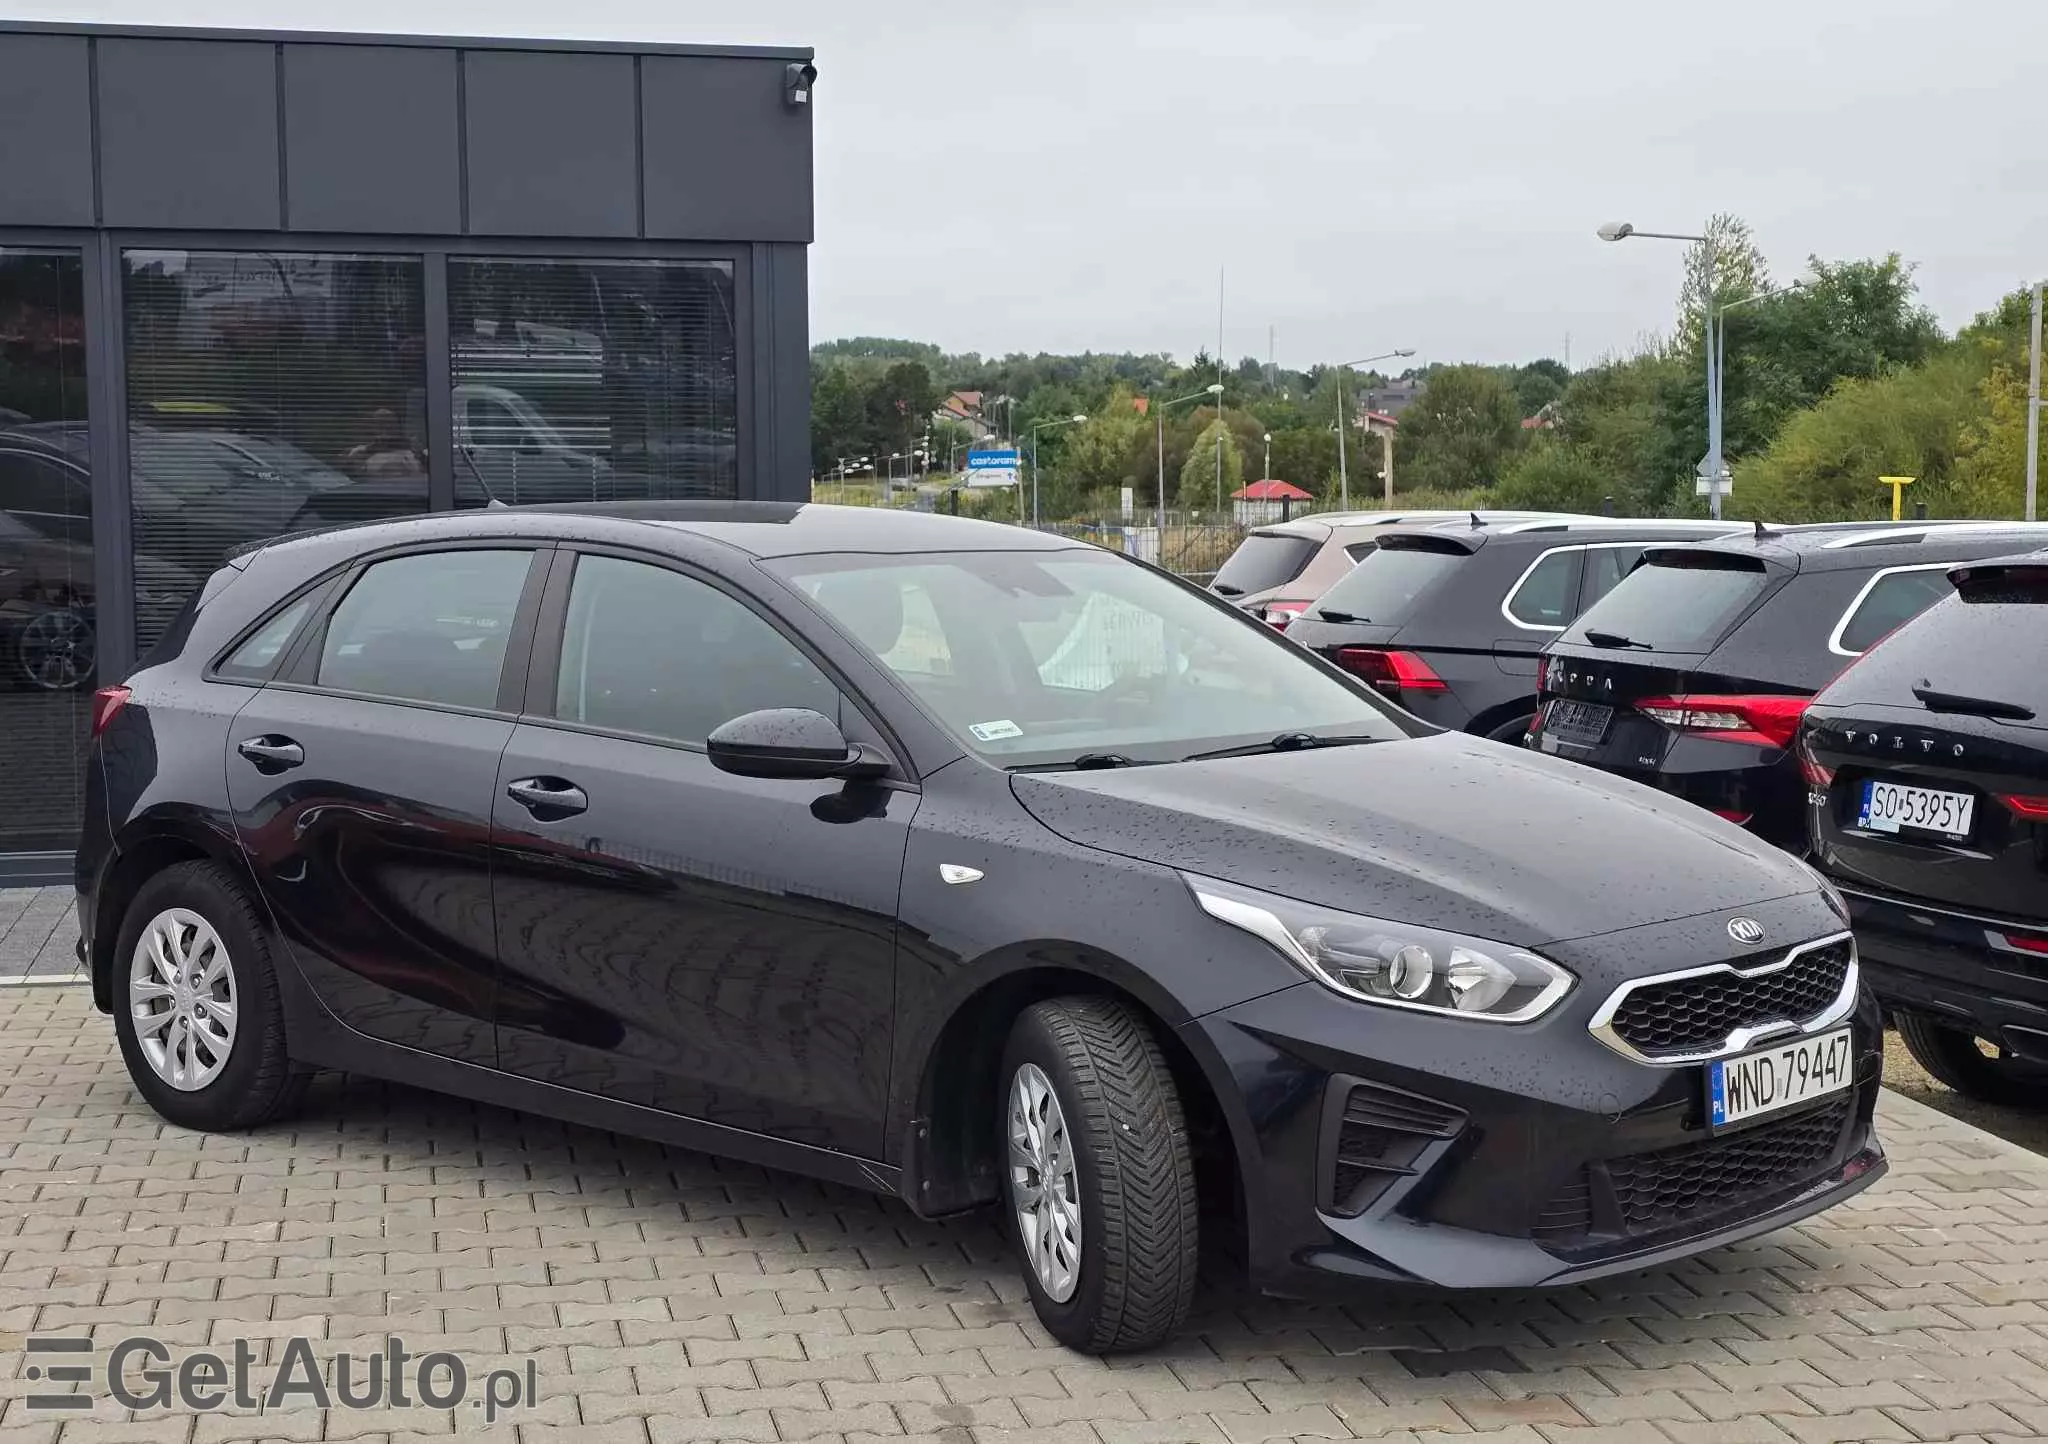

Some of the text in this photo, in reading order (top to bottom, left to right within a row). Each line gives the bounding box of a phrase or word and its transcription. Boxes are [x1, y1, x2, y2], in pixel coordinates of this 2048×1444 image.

[970, 456, 1020, 466] castoram
[1846, 730, 1964, 757] VOLVO
[1873, 786, 1969, 831] SO 5395Y
[1730, 918, 1765, 941] KIA
[1725, 1034, 1849, 1115] WND 79447
[1712, 1101, 1724, 1114] PL
